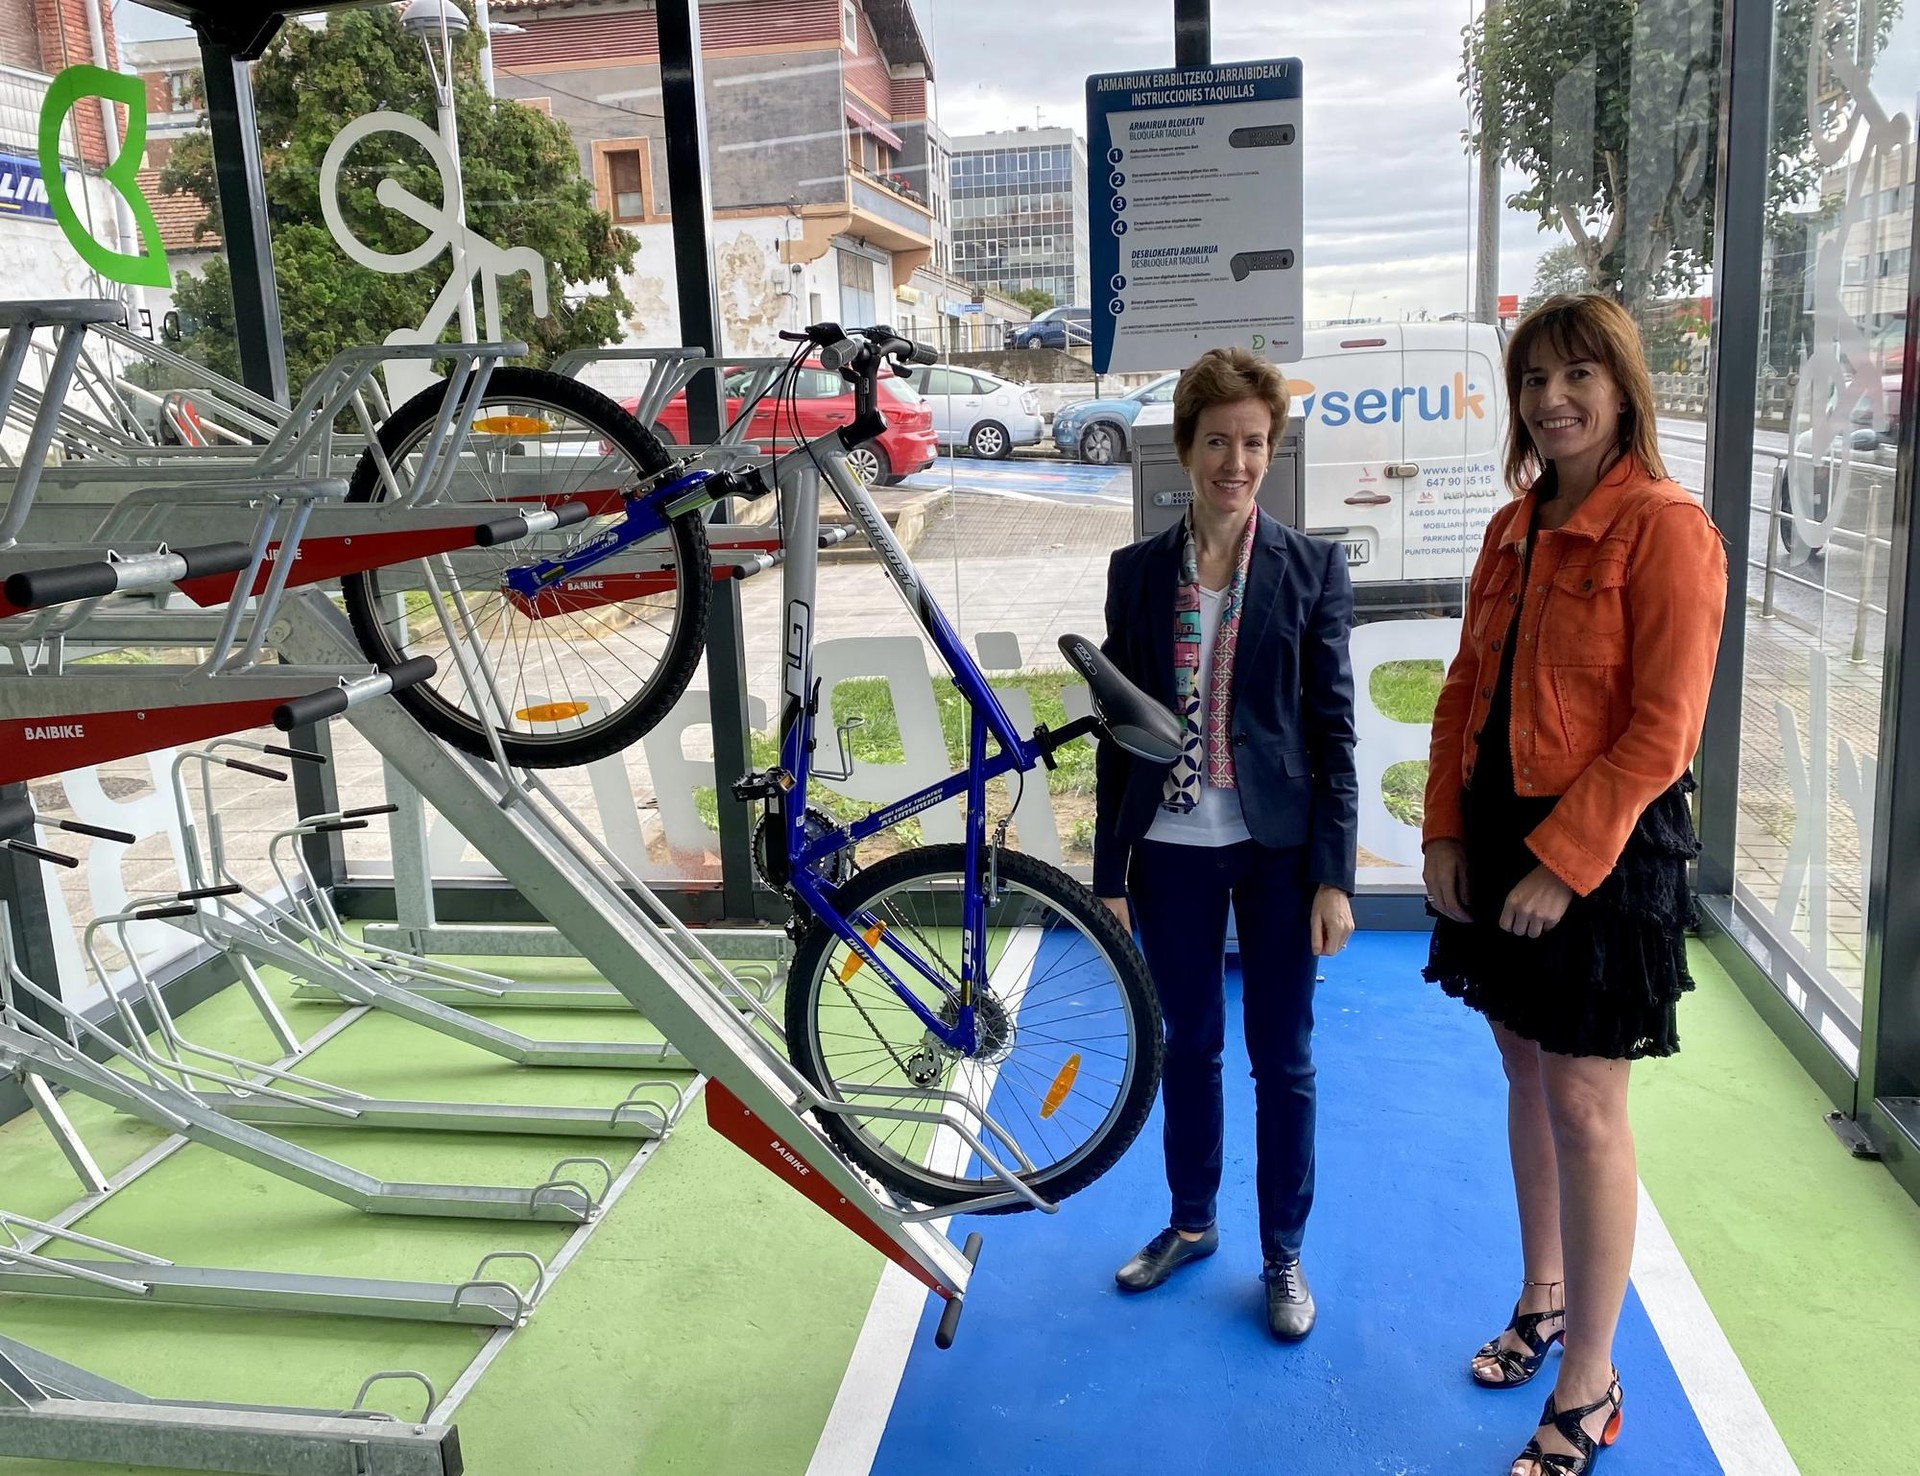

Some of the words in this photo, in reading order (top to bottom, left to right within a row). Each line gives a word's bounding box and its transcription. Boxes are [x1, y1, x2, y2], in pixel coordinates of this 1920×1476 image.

[1097, 75, 1151, 92] ARMAIRUAK
[1153, 70, 1214, 87] ERABILTZEKO
[1215, 65, 1281, 83] JARRAIBIDEAK
[1131, 88, 1202, 106] INSTRUCCIONES
[1204, 84, 1255, 101] TAQUILLAS
[1129, 119, 1167, 131] ARMAIRUA
[1168, 117, 1205, 128] BLOKEATU
[1129, 130, 1164, 141] BLOQUEAR
[1165, 128, 1196, 138] TAQUILLA
[1131, 247, 1179, 259] DESBLOKEATU
[1180, 245, 1218, 256] ARMAIRUA
[1131, 257, 1178, 269] DESBLOQUEAR
[1178, 255, 1210, 266] TAQUILLA
[1321, 371, 1485, 426] seruk
[1423, 464, 1496, 475] www.seuk.es
[1426, 478, 1446, 487] 647
[1447, 477, 1461, 487] 90
[1480, 476, 1492, 485] 15
[1409, 508, 1435, 517] ASEOS
[855, 501, 916, 588] OUTPOST
[1422, 534, 1457, 542] PARKING
[1343, 543, 1363, 560] WK
[1405, 548, 1431, 556] PUNTO
[24, 724, 85, 741] BAIBIKE
[895, 802, 913, 814] HEAT
[914, 788, 943, 805] TREATED
[846, 938, 898, 988] OUTPOST
[770, 1140, 810, 1176] BAIBIKE
